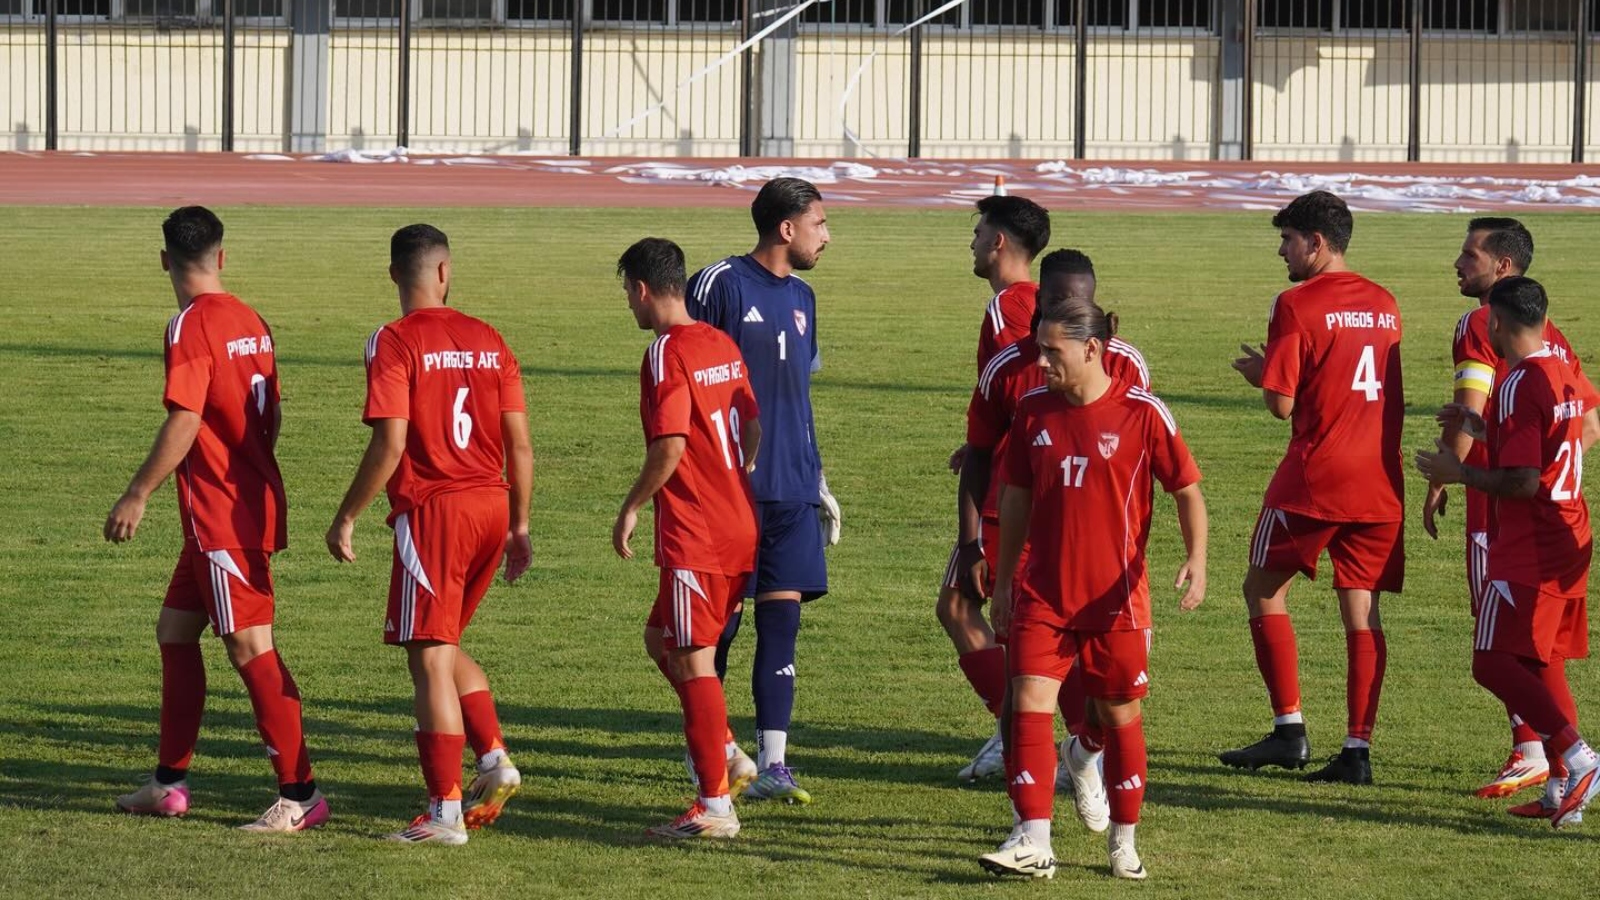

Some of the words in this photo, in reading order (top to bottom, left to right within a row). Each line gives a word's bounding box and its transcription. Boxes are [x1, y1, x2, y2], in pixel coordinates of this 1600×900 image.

[1325, 311, 1374, 330] PYRGOS
[1377, 313, 1398, 331] AFC
[423, 351, 474, 372] PYRGOS
[477, 351, 500, 369] AFC
[777, 331, 787, 360] 1
[1351, 345, 1383, 402] 4
[453, 387, 473, 449] 6
[710, 406, 744, 470] 19
[1060, 455, 1089, 488] 17
